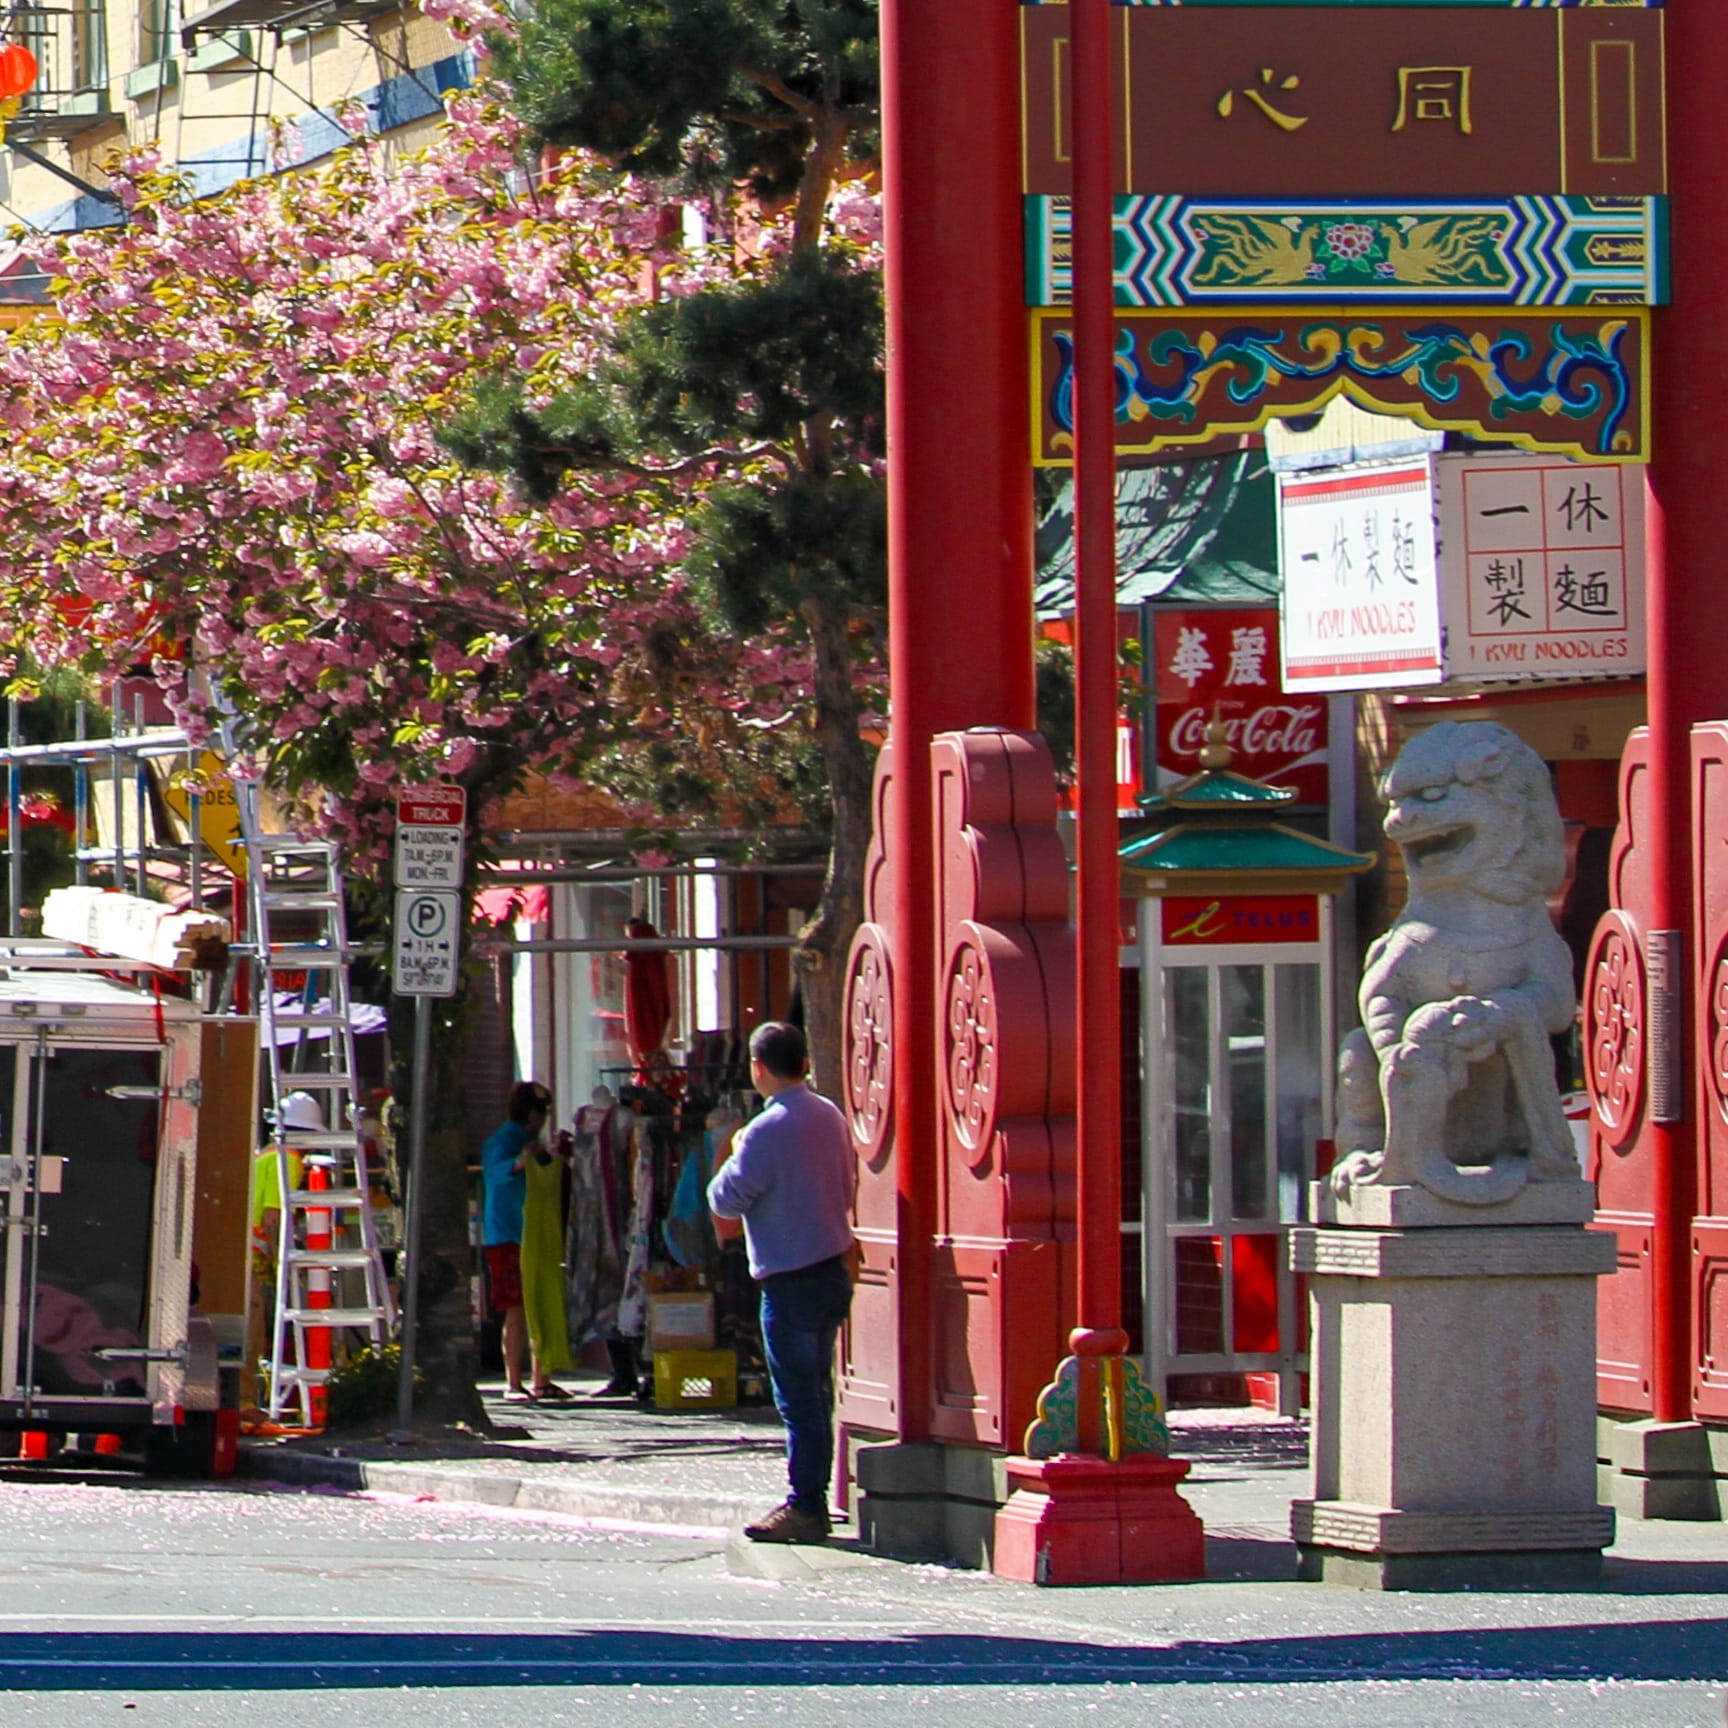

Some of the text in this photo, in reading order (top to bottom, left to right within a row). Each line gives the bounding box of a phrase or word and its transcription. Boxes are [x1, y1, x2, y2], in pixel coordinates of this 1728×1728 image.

[1485, 642, 1527, 663] KYU
[1534, 637, 1629, 660] NOODLES
[411, 806, 451, 822] TRUCK
[417, 904, 437, 929] P
[1233, 909, 1313, 928] TELUS
